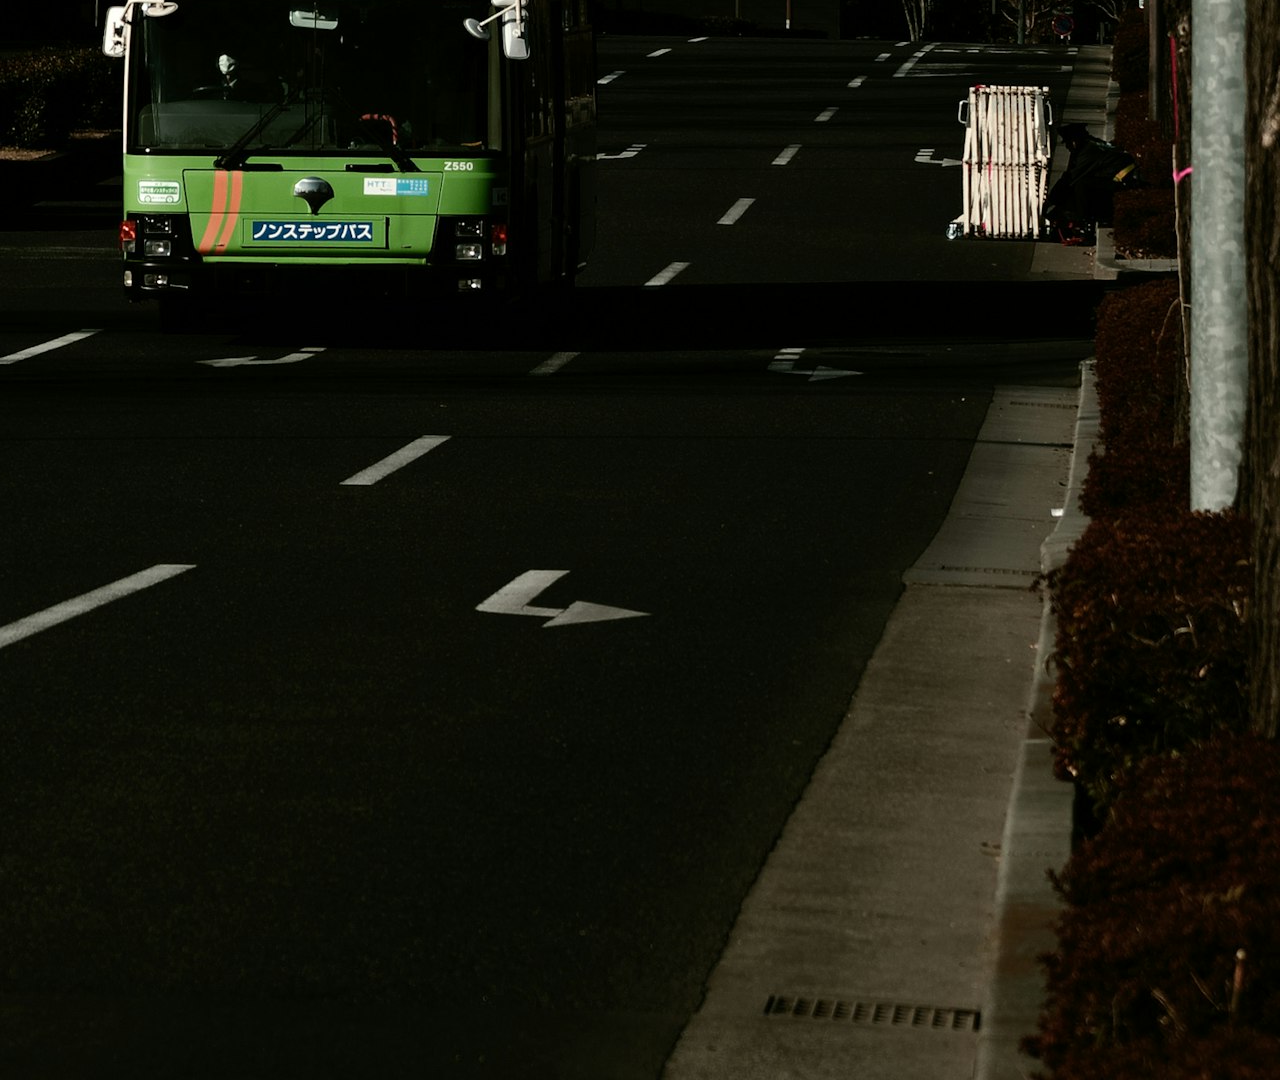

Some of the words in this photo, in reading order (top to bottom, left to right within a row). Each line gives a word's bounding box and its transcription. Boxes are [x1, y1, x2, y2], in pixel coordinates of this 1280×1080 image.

[444, 161, 474, 171] Z550
[253, 223, 373, 240] ノンステップバス
